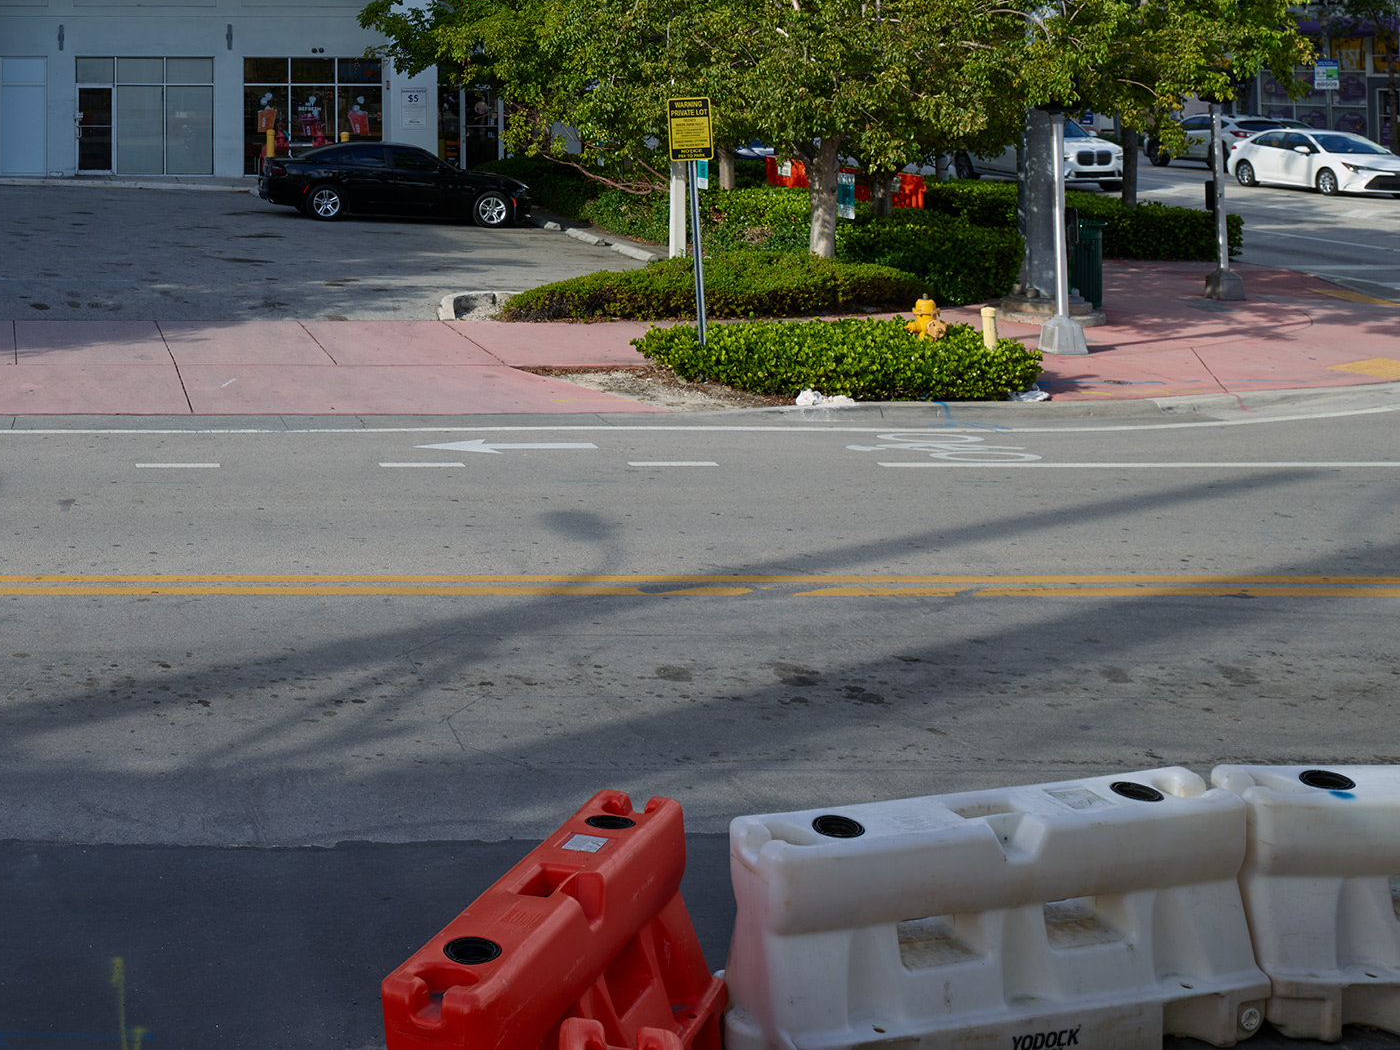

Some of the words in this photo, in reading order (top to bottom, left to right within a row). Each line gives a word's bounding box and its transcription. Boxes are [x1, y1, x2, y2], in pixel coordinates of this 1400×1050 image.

[408, 93, 419, 103] $5
[674, 100, 703, 108] WARNING
[670, 109, 695, 117] PRIVATE
[695, 108, 708, 116] LOT
[1012, 1028, 1080, 1050] YODOCK
